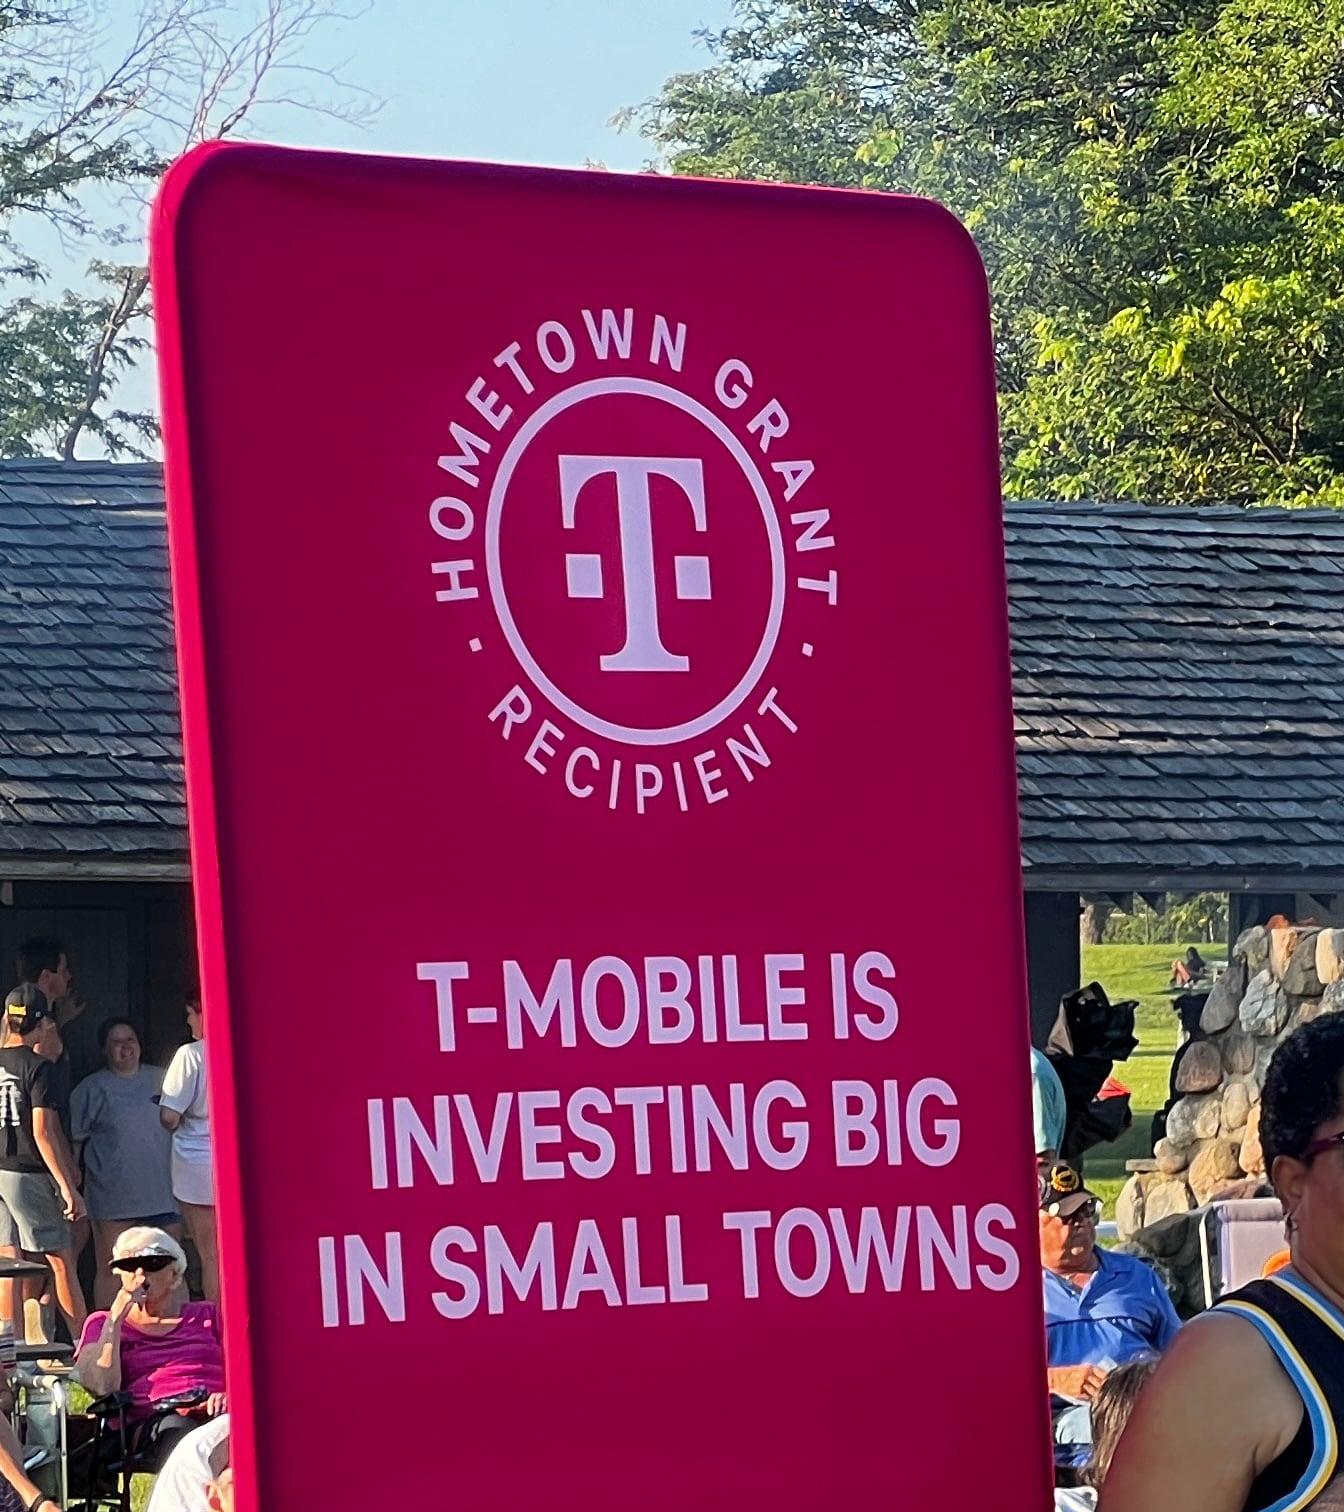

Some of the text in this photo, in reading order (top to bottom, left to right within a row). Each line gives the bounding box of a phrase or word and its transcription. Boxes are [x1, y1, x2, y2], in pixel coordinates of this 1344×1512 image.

[429, 308, 837, 606] HOMETOWN GRANT
[557, 454, 712, 671] T
[488, 684, 798, 814] RECIPIENT
[416, 950, 899, 1052] T-MOBILE IS
[366, 1076, 961, 1189] INVESTING BIG
[318, 1202, 1020, 1328] IN SMALL TOWNS
